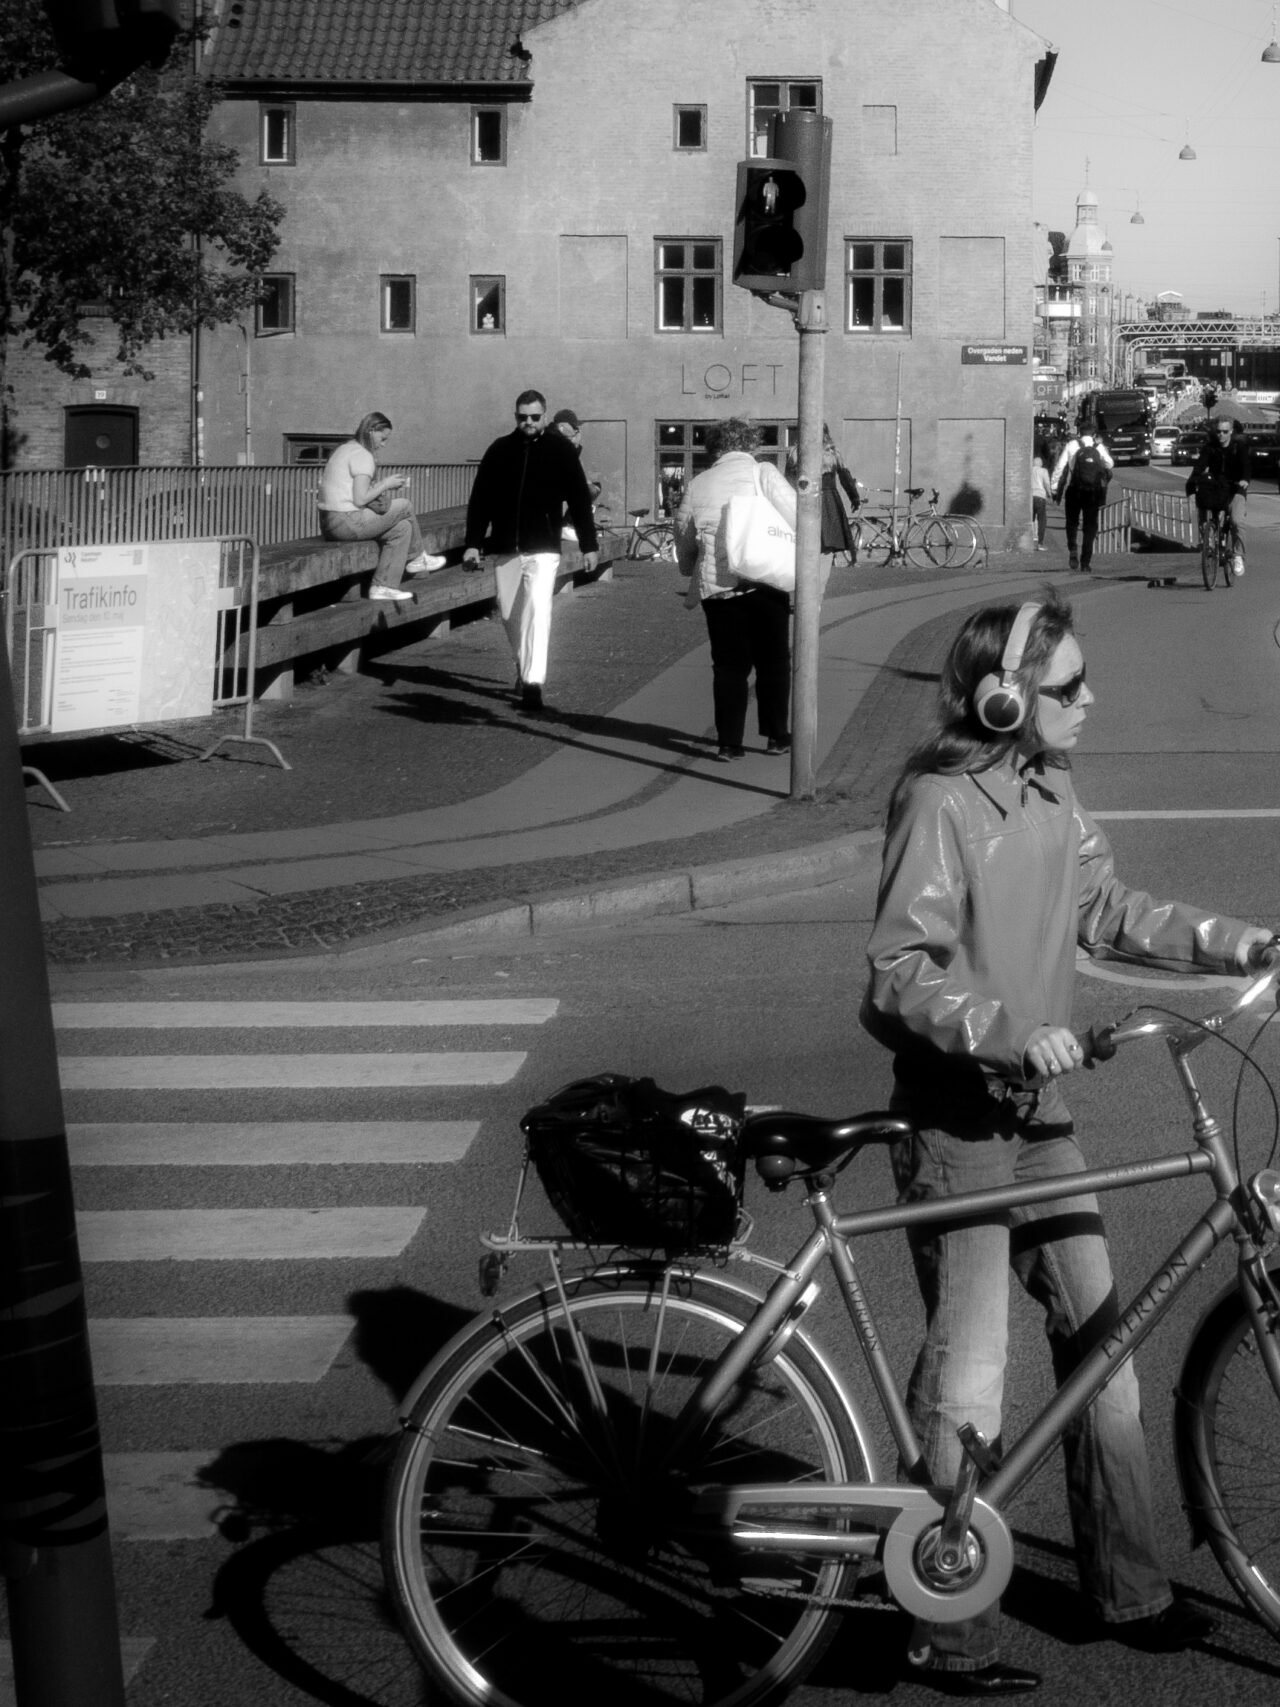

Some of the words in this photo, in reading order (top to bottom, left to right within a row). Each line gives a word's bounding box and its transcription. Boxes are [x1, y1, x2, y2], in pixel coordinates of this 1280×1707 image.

[967, 347, 1002, 355] Overgaden
[681, 363, 784, 395] LOFT
[1035, 385, 1059, 395] OFT
[63, 584, 137, 610] Trafikinfo
[1101, 1252, 1188, 1359] EVERTON
